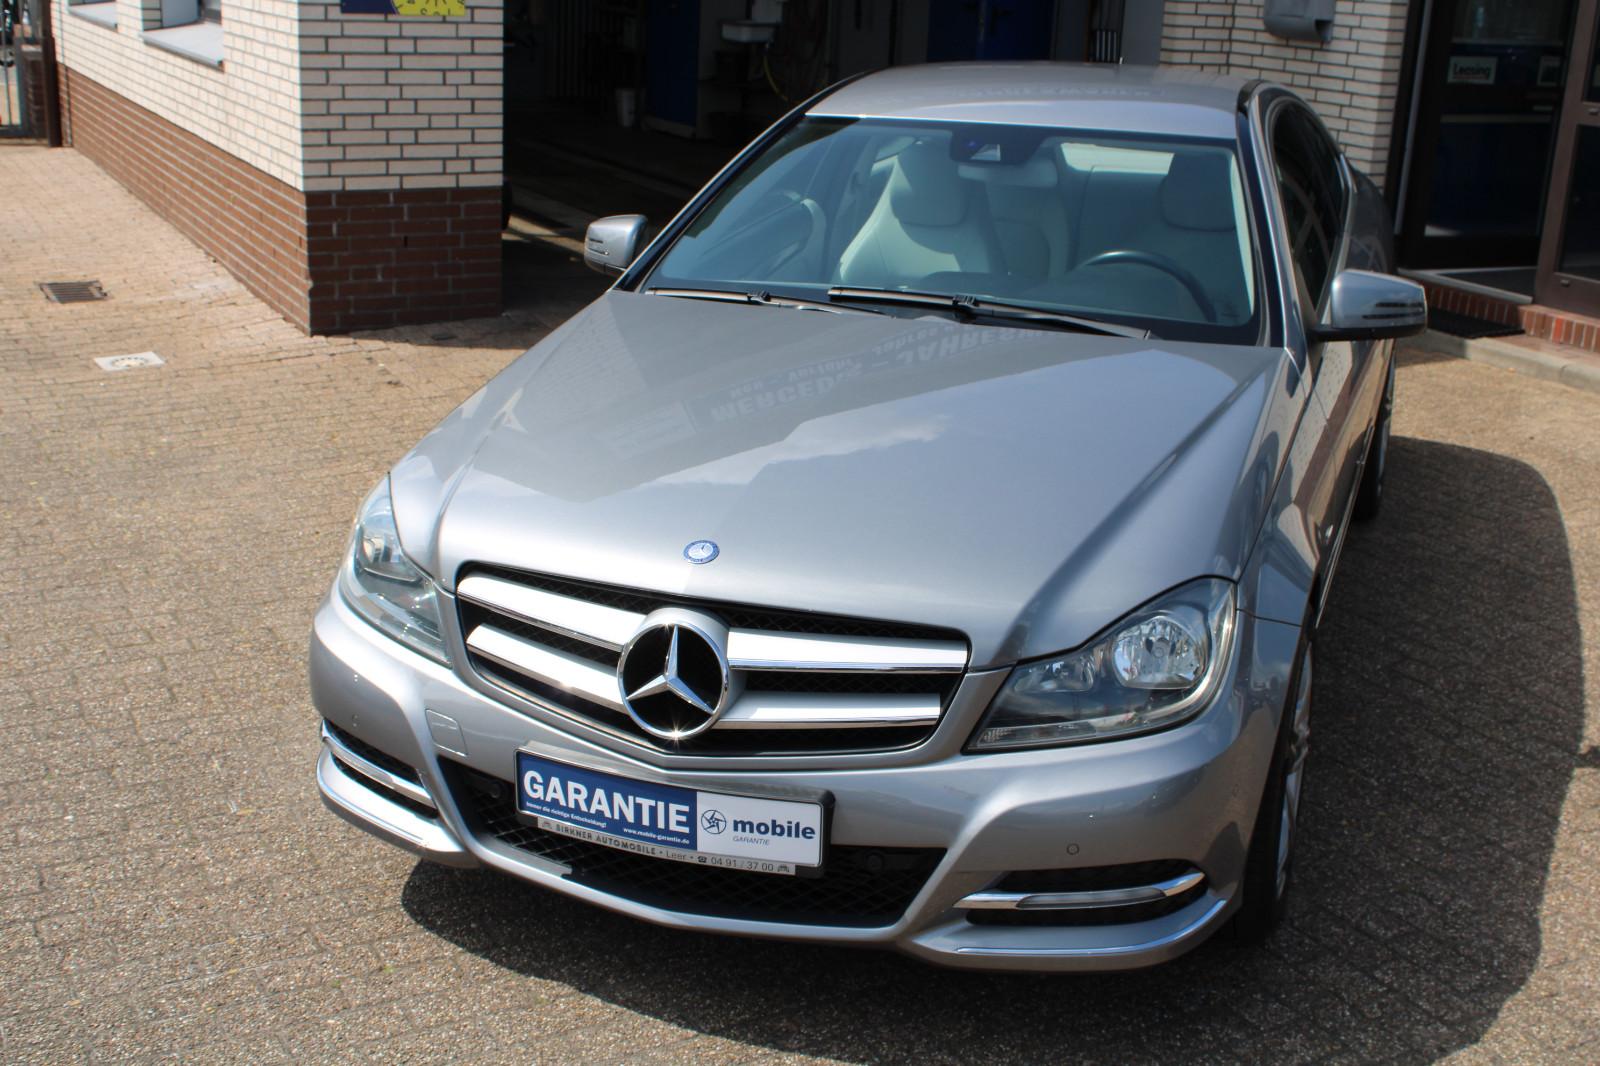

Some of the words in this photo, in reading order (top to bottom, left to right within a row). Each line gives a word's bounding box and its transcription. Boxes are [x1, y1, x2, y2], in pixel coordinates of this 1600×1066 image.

[1454, 63, 1491, 79] Leasing
[523, 770, 690, 834] GARANTIE
[623, 828, 690, 844] www.mobile-garantie.de
[733, 819, 816, 839] mobile
[556, 823, 593, 841] BIRKNER
[596, 835, 656, 855] AUTOMOBILE
[666, 850, 687, 860] Leer
[711, 857, 723, 866] 04
[725, 858, 737, 867] 91
[748, 861, 759, 870] 37
[761, 862, 774, 872] 00
[733, 836, 770, 845] GARANTIE
